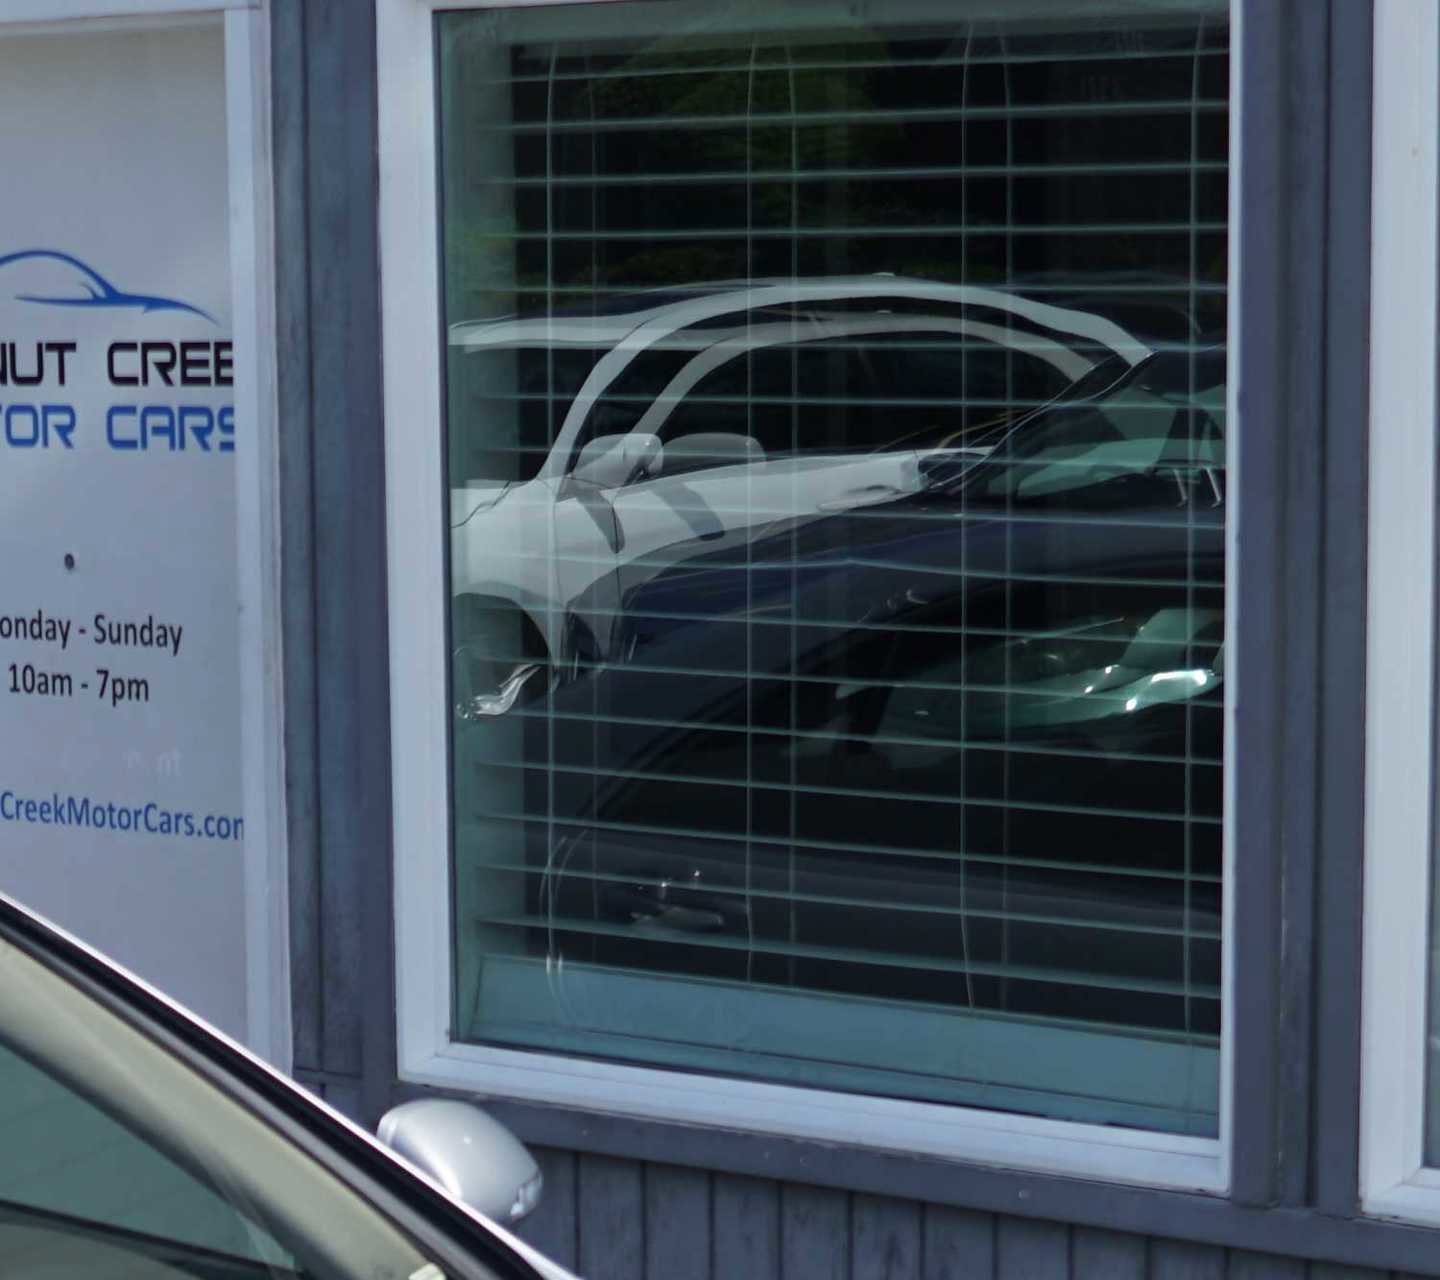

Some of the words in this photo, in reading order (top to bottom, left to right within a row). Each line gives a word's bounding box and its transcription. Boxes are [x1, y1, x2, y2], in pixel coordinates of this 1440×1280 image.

[94, 614, 183, 656] Sunday
[8, 662, 73, 696] 10am
[96, 668, 149, 707] 7pm
